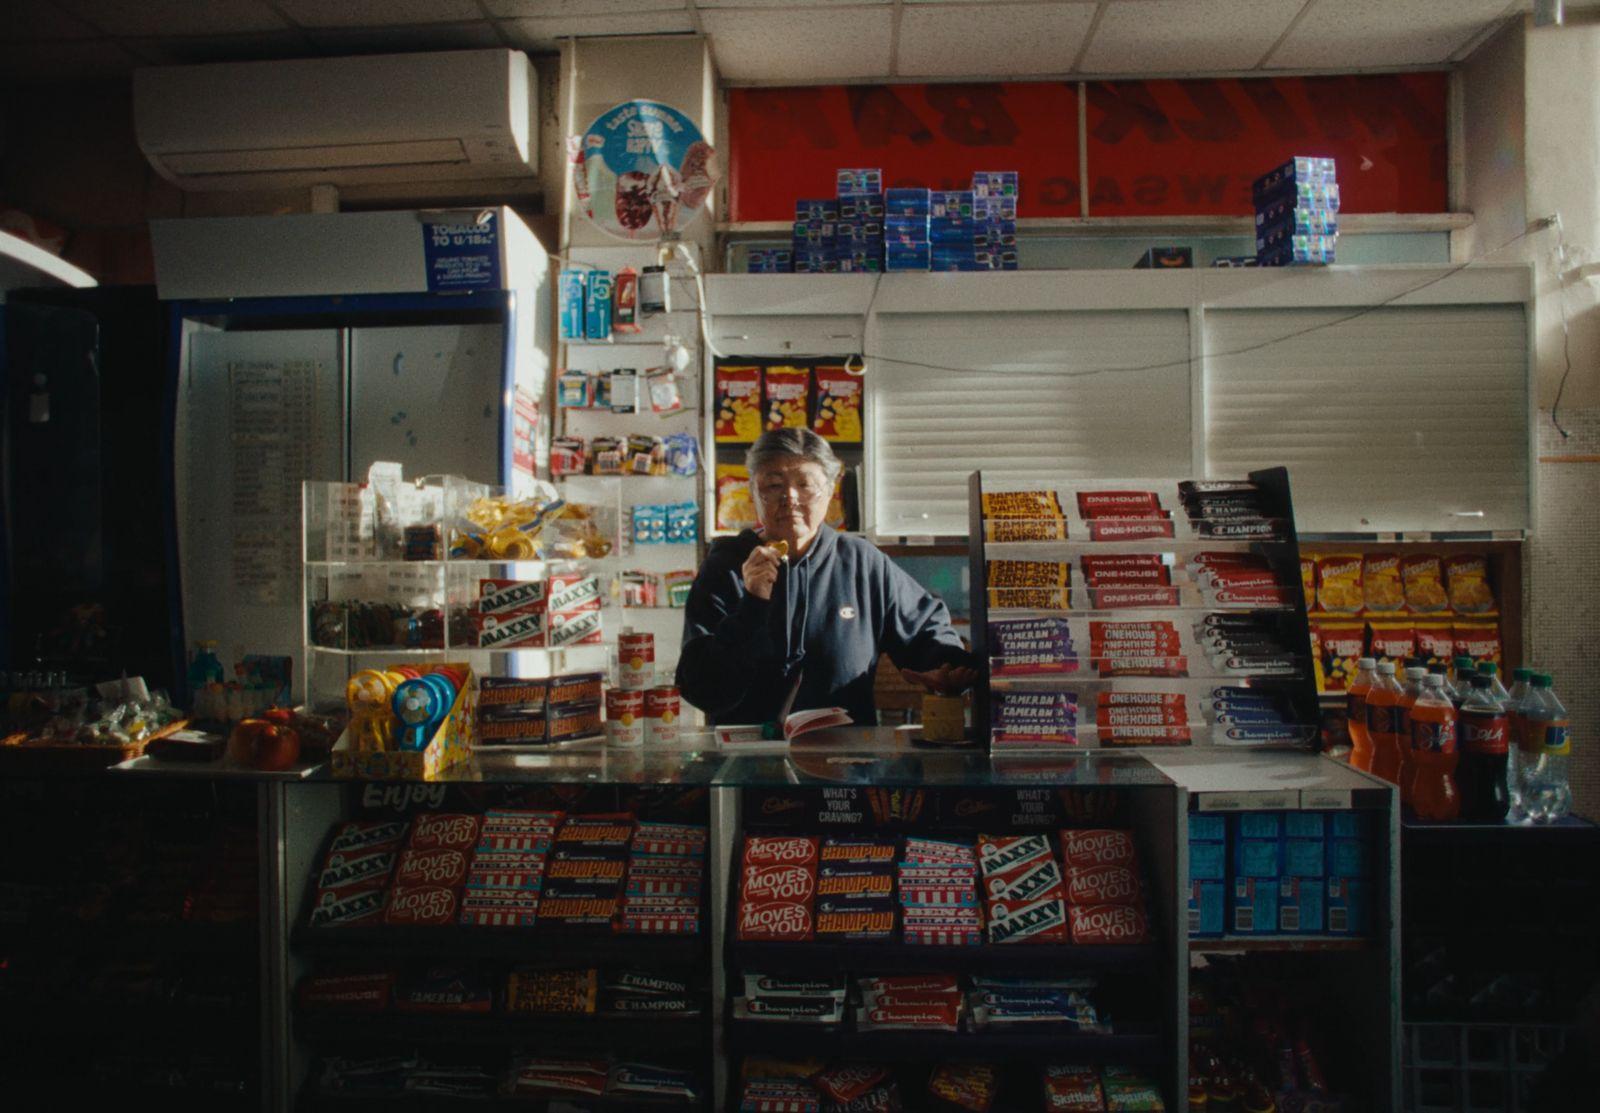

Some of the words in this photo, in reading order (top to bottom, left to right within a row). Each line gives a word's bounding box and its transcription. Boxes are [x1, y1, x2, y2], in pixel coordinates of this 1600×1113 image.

[432, 236, 449, 246] TO
[1110, 694, 1162, 703] ONEHOUSE
[1110, 715, 1163, 724] ONEHOUSE
[1112, 728, 1167, 737] ONEHOUSE
[362, 783, 447, 811] Enjoy
[822, 788, 857, 800] WHAT'S
[827, 800, 850, 812] YOUR
[1021, 802, 1044, 814] YOUR
[818, 812, 863, 823] CRAVING?
[417, 820, 474, 838] MOVES
[751, 839, 809, 853] MOVES
[1069, 833, 1126, 854] MOVES
[822, 846, 895, 860] CHAMPION
[403, 852, 461, 873] MOVES
[748, 868, 808, 890] MOVES
[818, 876, 892, 894] CHAMPION
[1072, 869, 1131, 891] MOVES
[392, 889, 451, 910] MOVES
[745, 905, 806, 928] MOVES
[817, 912, 894, 933] CHAMPION
[990, 900, 1060, 943] MAXXY
[1076, 908, 1136, 932] MOVES
[871, 1009, 943, 1022] Champion
[1052, 1092, 1096, 1105] Skittles
